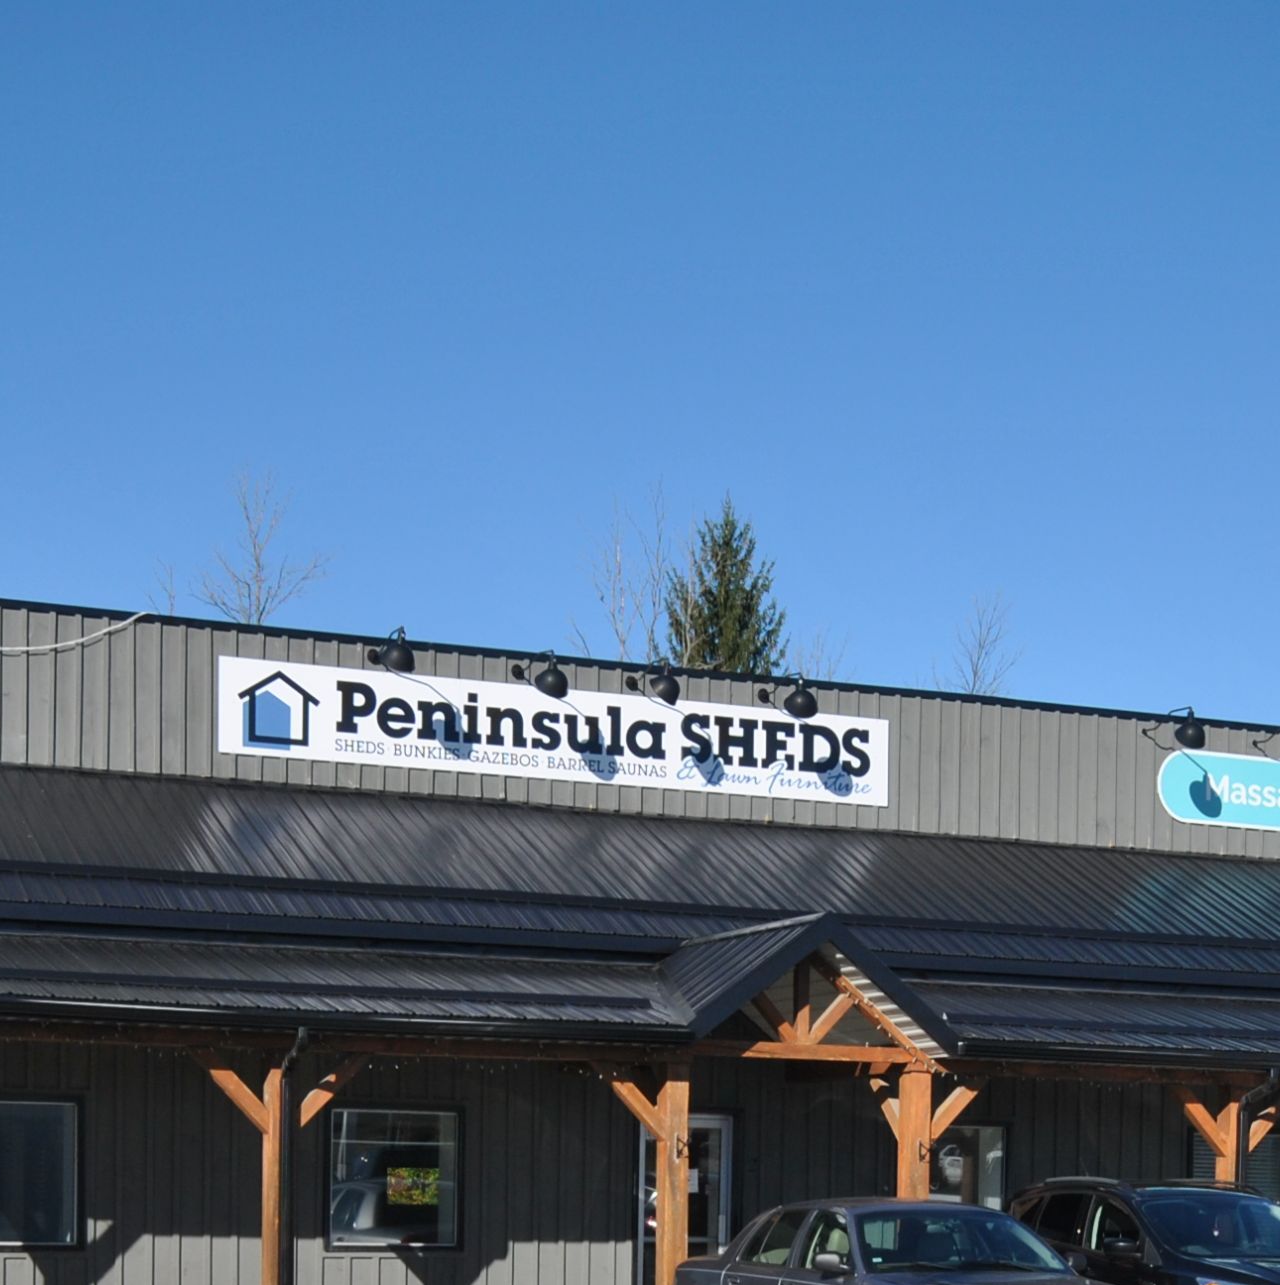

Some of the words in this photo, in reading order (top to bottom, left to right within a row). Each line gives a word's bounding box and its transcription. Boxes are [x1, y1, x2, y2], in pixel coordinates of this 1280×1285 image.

[336, 680, 666, 760] Peninsula
[681, 712, 870, 778] SHEDS
[335, 738, 385, 755] SHEDS
[394, 743, 460, 761] BUNKIES
[467, 749, 539, 767] GAZEBOS
[547, 756, 604, 773] BARREL
[608, 760, 667, 778] SAUNAS
[701, 762, 760, 787] Lawn
[766, 760, 872, 795] Furniture
